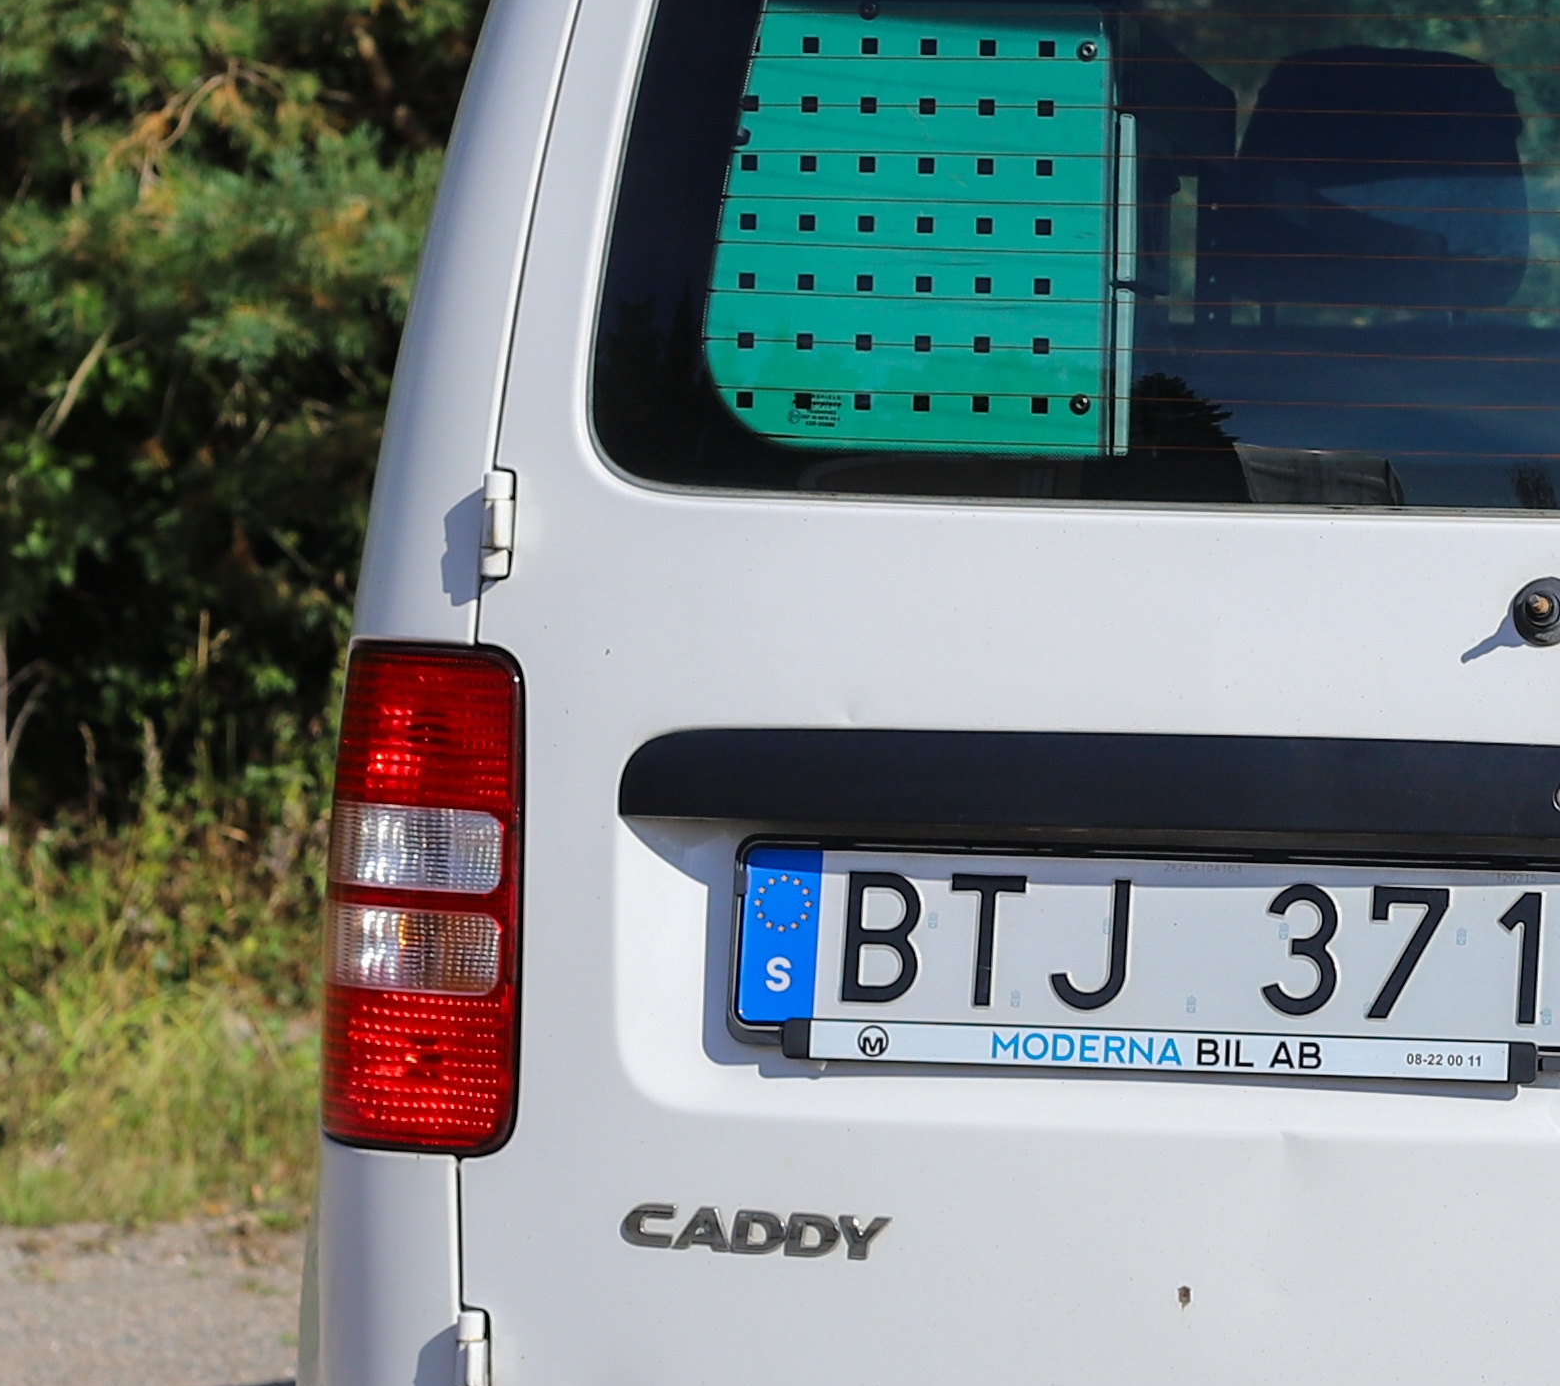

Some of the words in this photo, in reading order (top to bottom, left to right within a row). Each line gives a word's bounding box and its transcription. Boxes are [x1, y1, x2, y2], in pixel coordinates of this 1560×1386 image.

[841, 870, 1132, 1011] BTJ
[1262, 883, 1543, 1025] 371
[765, 956, 792, 992] S
[991, 1031, 1182, 1066] MODERNA
[1196, 1038, 1255, 1068] BIL
[1269, 1040, 1322, 1070] AB
[1406, 1053, 1444, 1066] 08-22
[1447, 1054, 1464, 1067] 00
[1468, 1055, 1481, 1067] 11
[620, 1202, 893, 1261] CADDY
